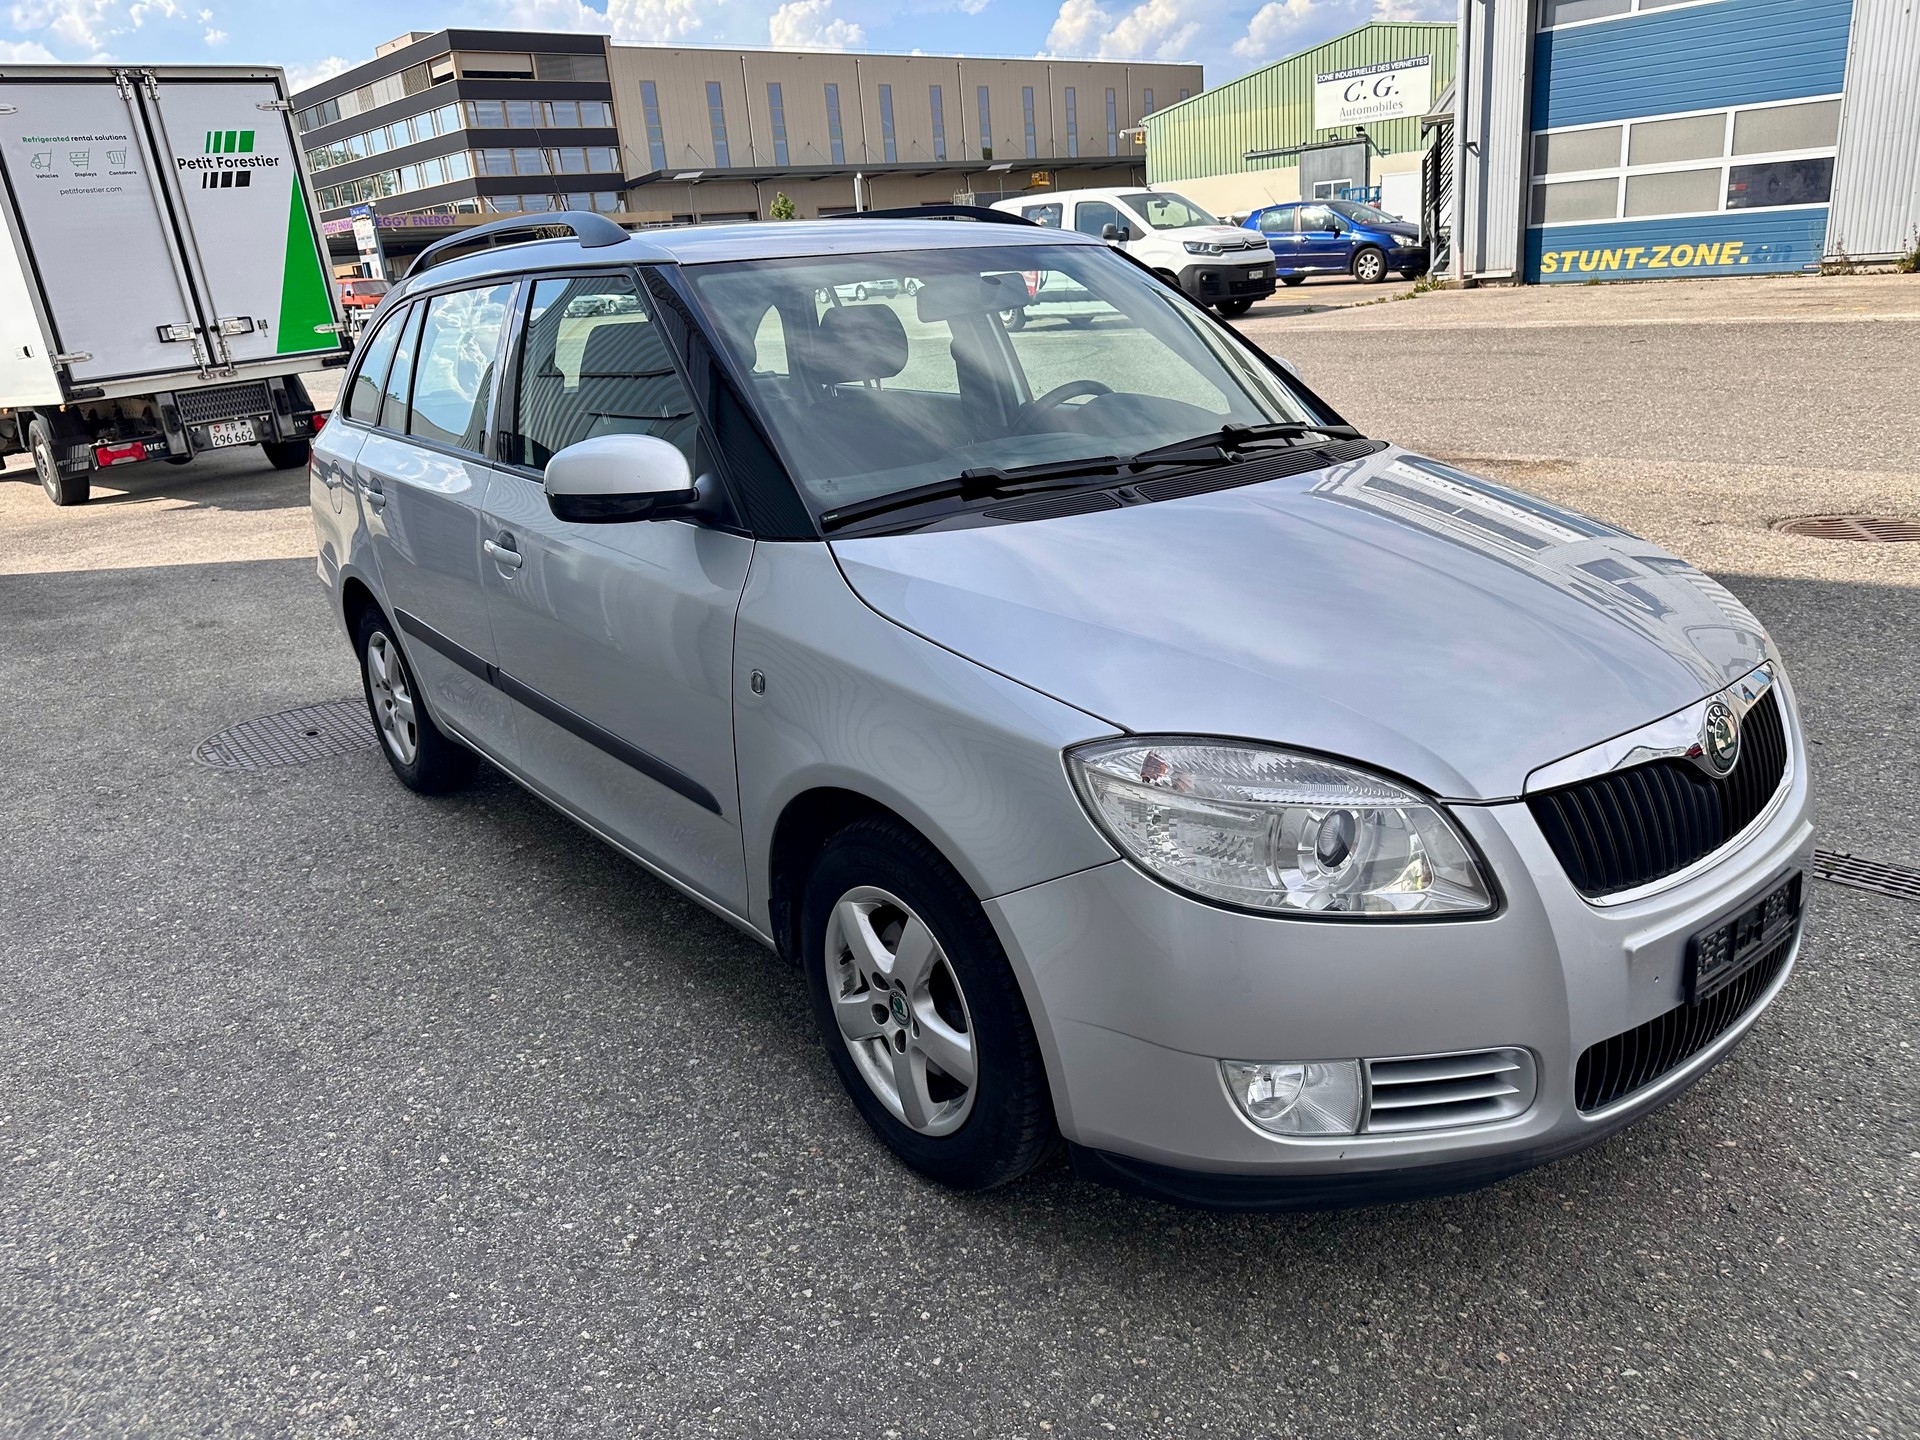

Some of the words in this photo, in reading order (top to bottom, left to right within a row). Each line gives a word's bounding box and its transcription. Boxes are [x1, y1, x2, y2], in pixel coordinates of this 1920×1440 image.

[1318, 73, 1335, 82] ZONE
[1335, 66, 1376, 79] INDUSTRIELLE
[1377, 63, 1390, 72] DES
[1391, 57, 1428, 70] VERNETTES
[1339, 101, 1403, 117] Automobiles
[22, 136, 70, 144] Refrigerated
[71, 134, 93, 142] rental
[177, 157, 214, 170] Petit
[216, 155, 279, 168] Forestier
[60, 187, 122, 196] petitforestier.com
[376, 216, 408, 227] EGGY
[413, 215, 456, 225] ENERGY
[225, 420, 237, 432] FR
[213, 433, 233, 446] 296
[235, 430, 254, 443] 662
[143, 442, 167, 452] IVEC
